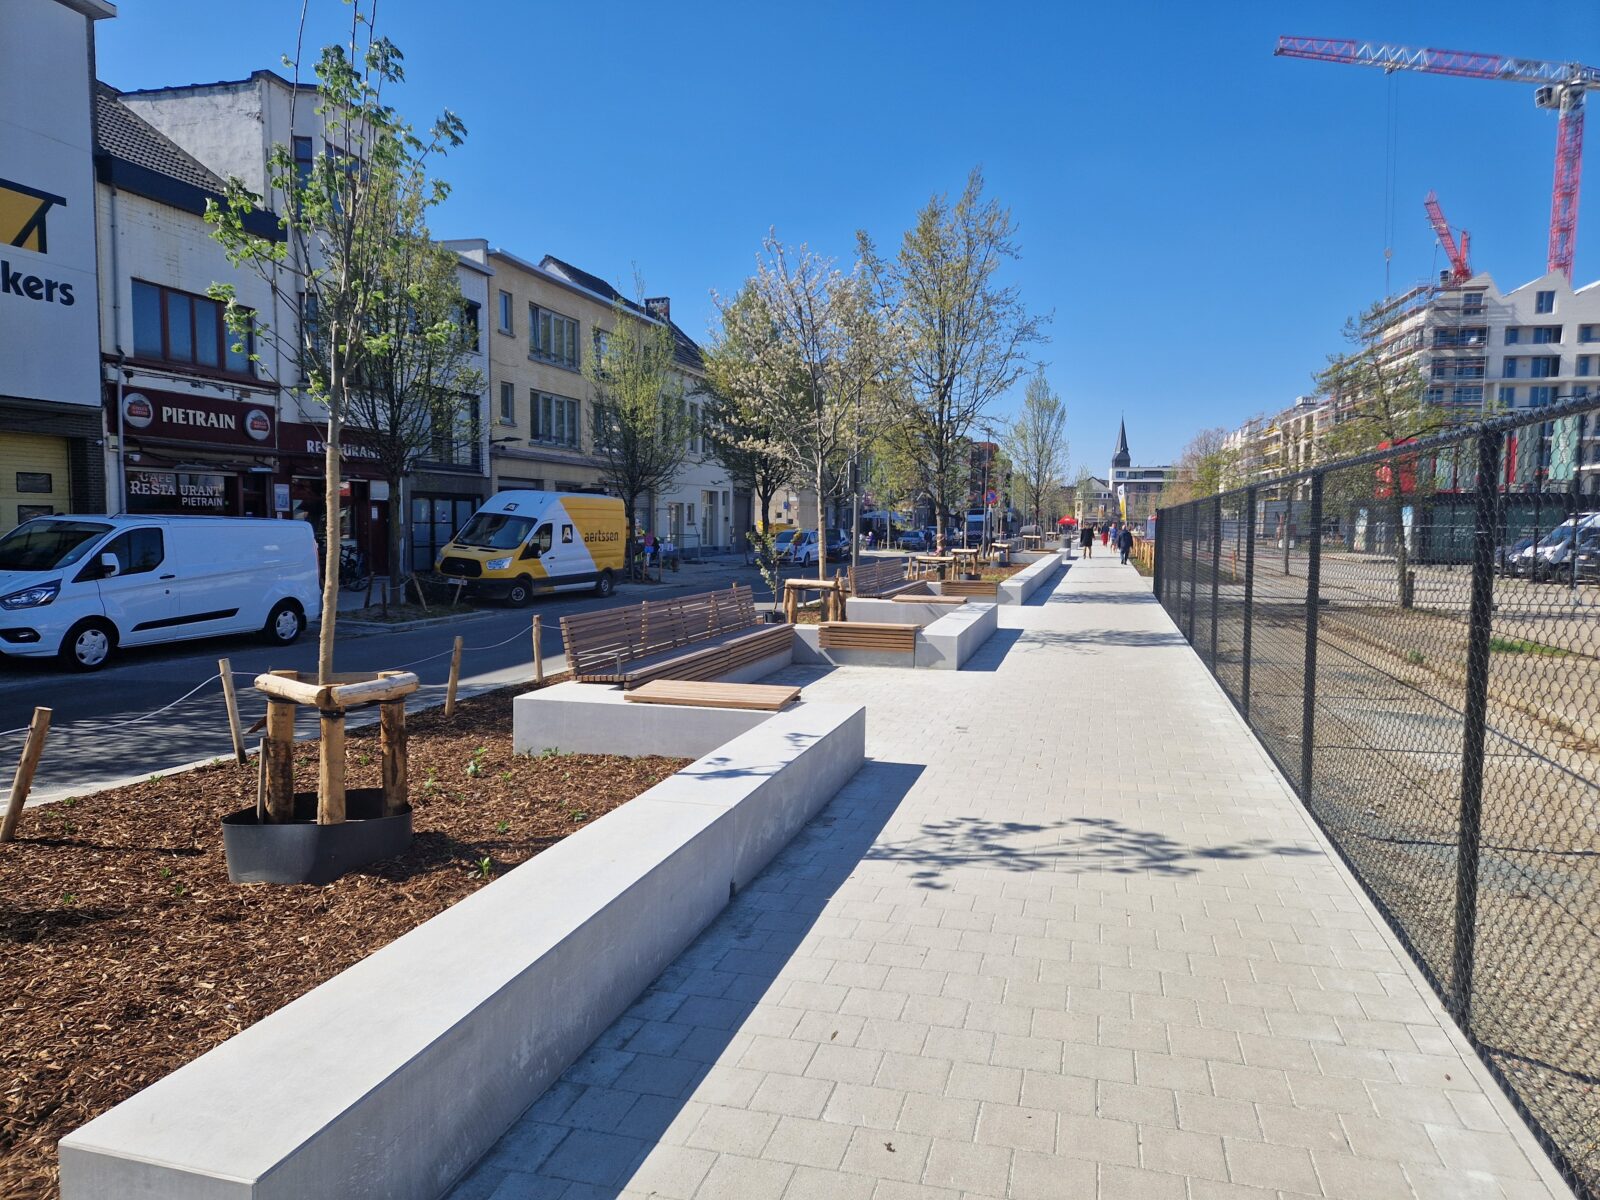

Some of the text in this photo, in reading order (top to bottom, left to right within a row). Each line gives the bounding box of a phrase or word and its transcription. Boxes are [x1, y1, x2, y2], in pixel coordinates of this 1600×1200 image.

[1, 260, 75, 306] kers
[162, 406, 236, 430] PIETRAIN
[181, 497, 223, 507] PIETRAIN
[584, 529, 619, 543] aertssen
